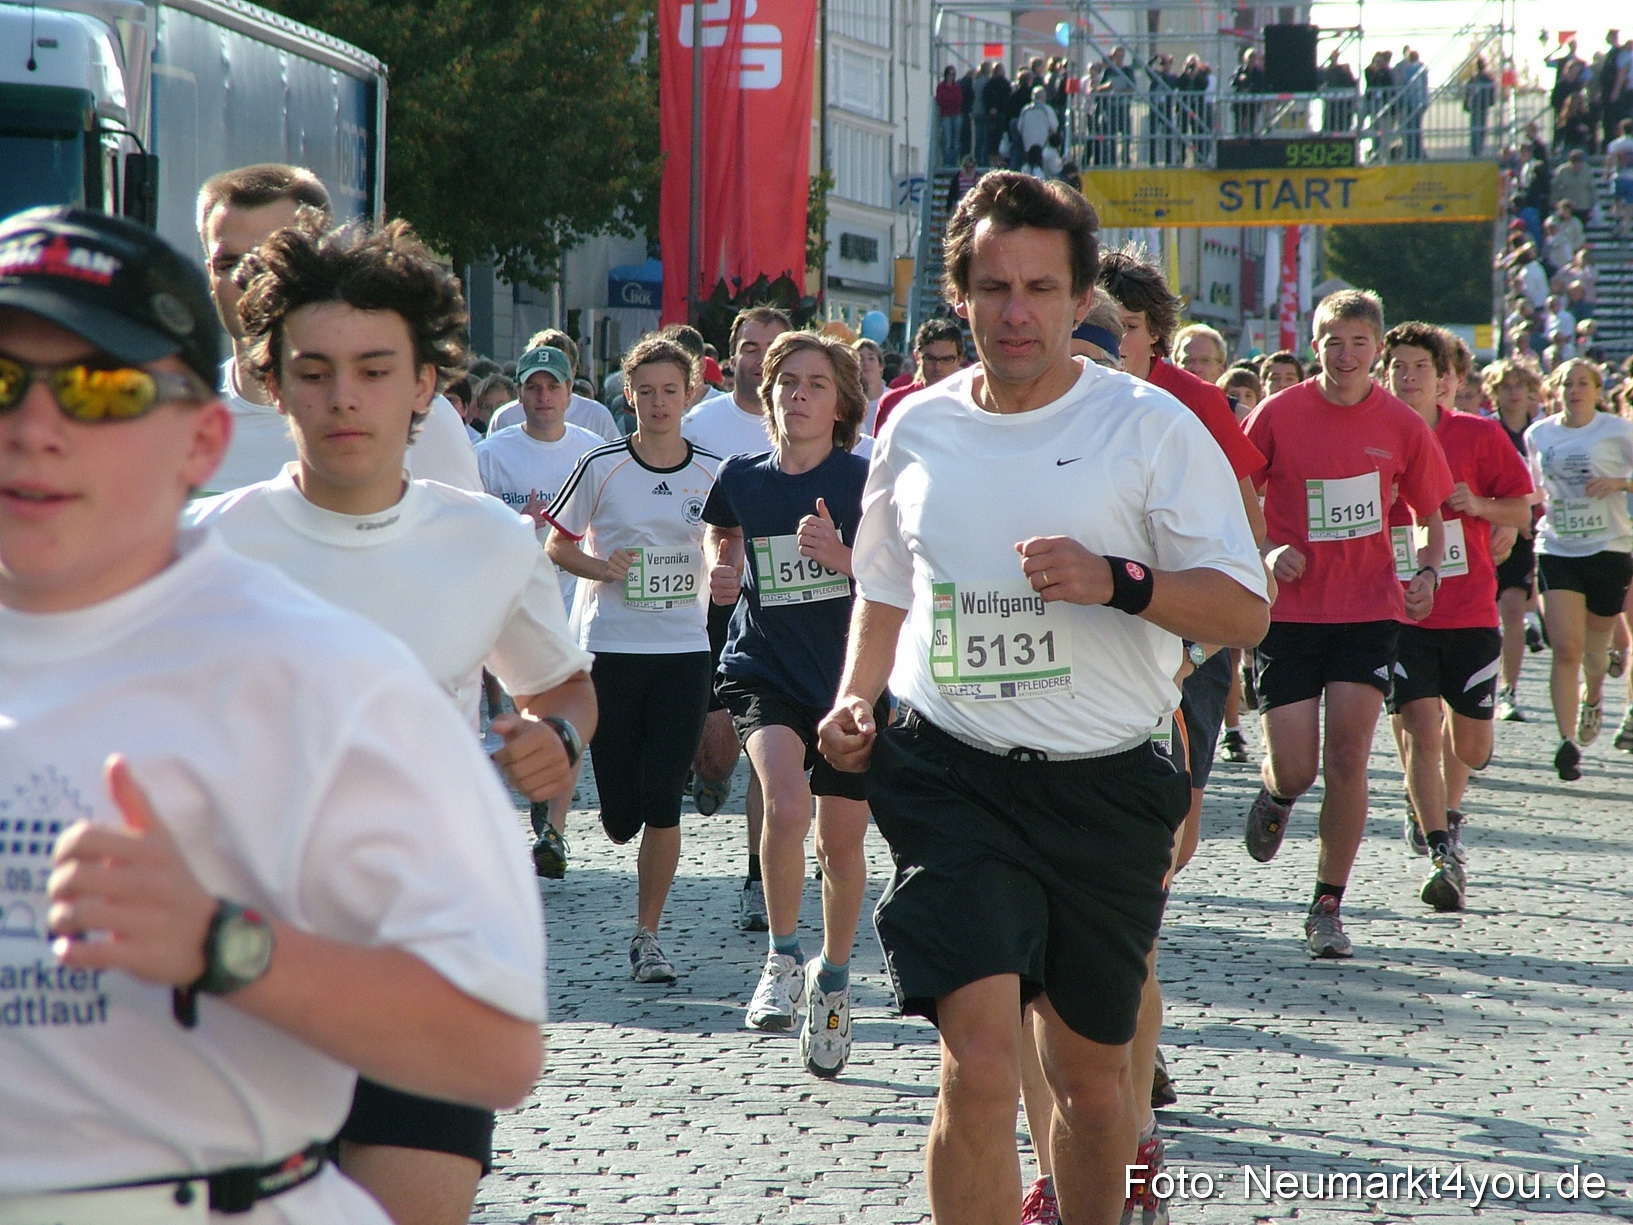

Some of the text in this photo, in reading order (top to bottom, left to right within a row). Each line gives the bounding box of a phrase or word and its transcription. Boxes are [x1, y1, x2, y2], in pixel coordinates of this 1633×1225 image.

[1219, 177, 1358, 212] START
[538, 351, 550, 363] B
[1331, 501, 1374, 523] 5191
[1570, 515, 1603, 529] 5141
[647, 552, 690, 565] Veronika
[628, 572, 639, 582] Sc
[649, 573, 695, 593] 5129
[960, 591, 1045, 618] Wolfgang
[935, 629, 948, 646] Sc
[966, 630, 1055, 668] 5131
[1017, 675, 1072, 691] PFLEIDERER
